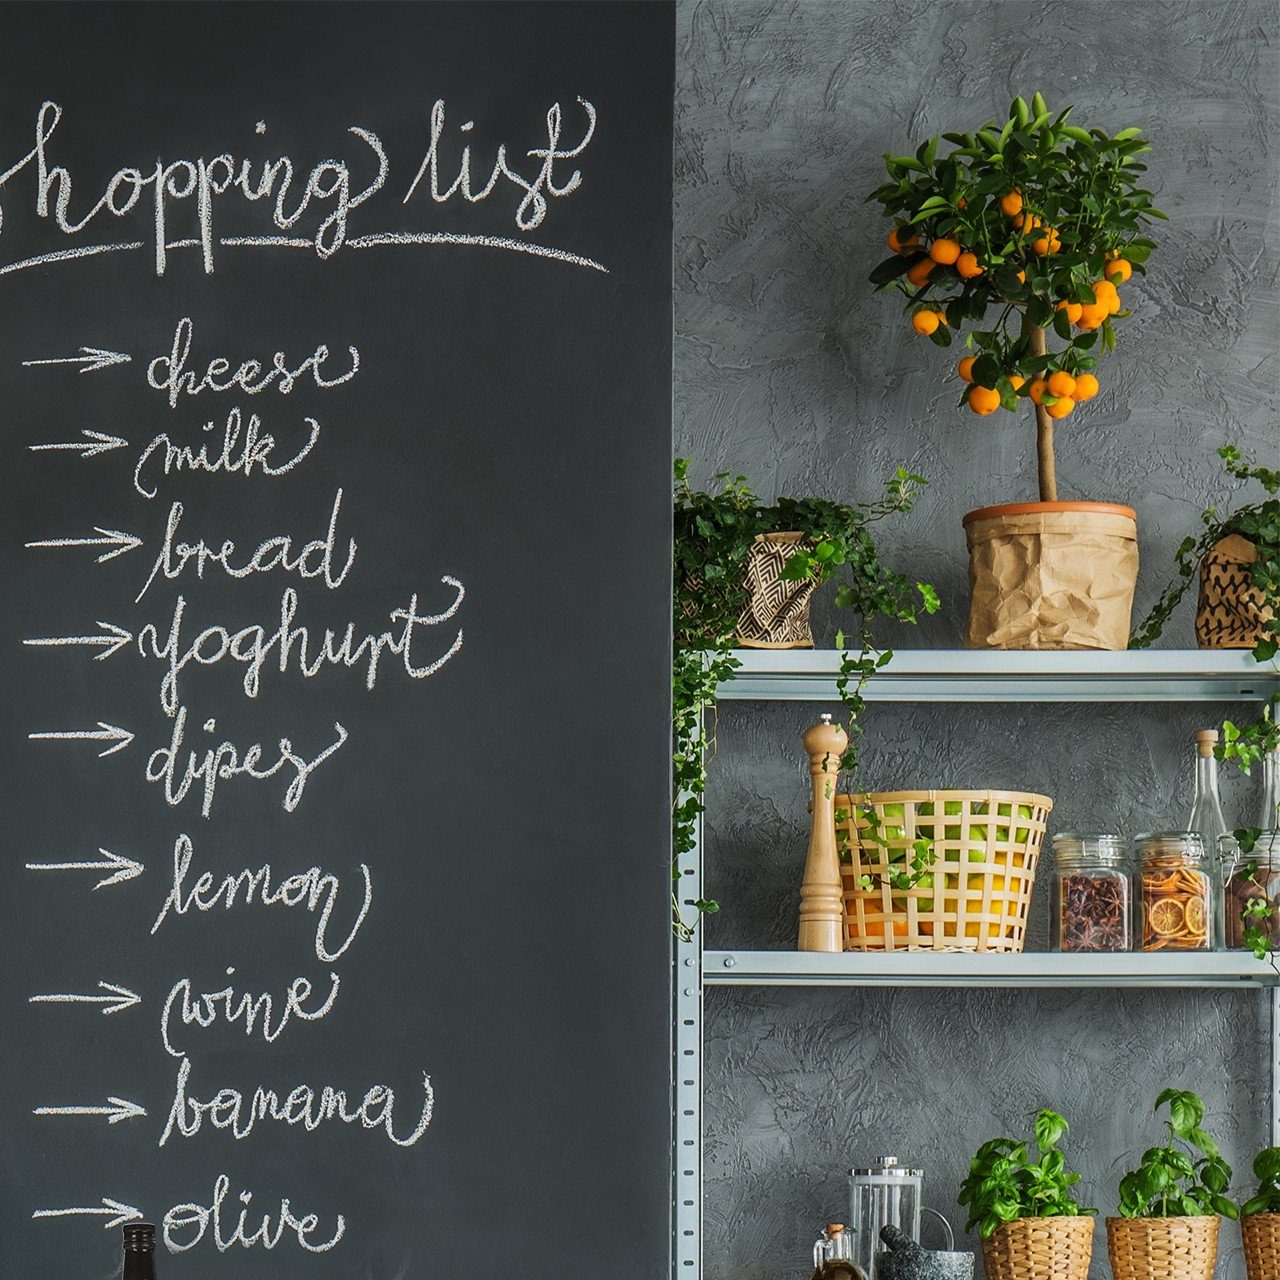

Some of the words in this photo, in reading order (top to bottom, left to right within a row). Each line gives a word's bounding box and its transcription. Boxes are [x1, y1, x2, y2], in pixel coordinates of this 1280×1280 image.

[403, 96, 596, 231] list
[147, 318, 359, 408] cheese
[134, 406, 320, 499] milk
[135, 488, 357, 603] bread
[151, 834, 372, 962] lemon
[160, 967, 341, 1057] wine
[159, 1057, 435, 1148] banana
[162, 1175, 346, 1254] olive
